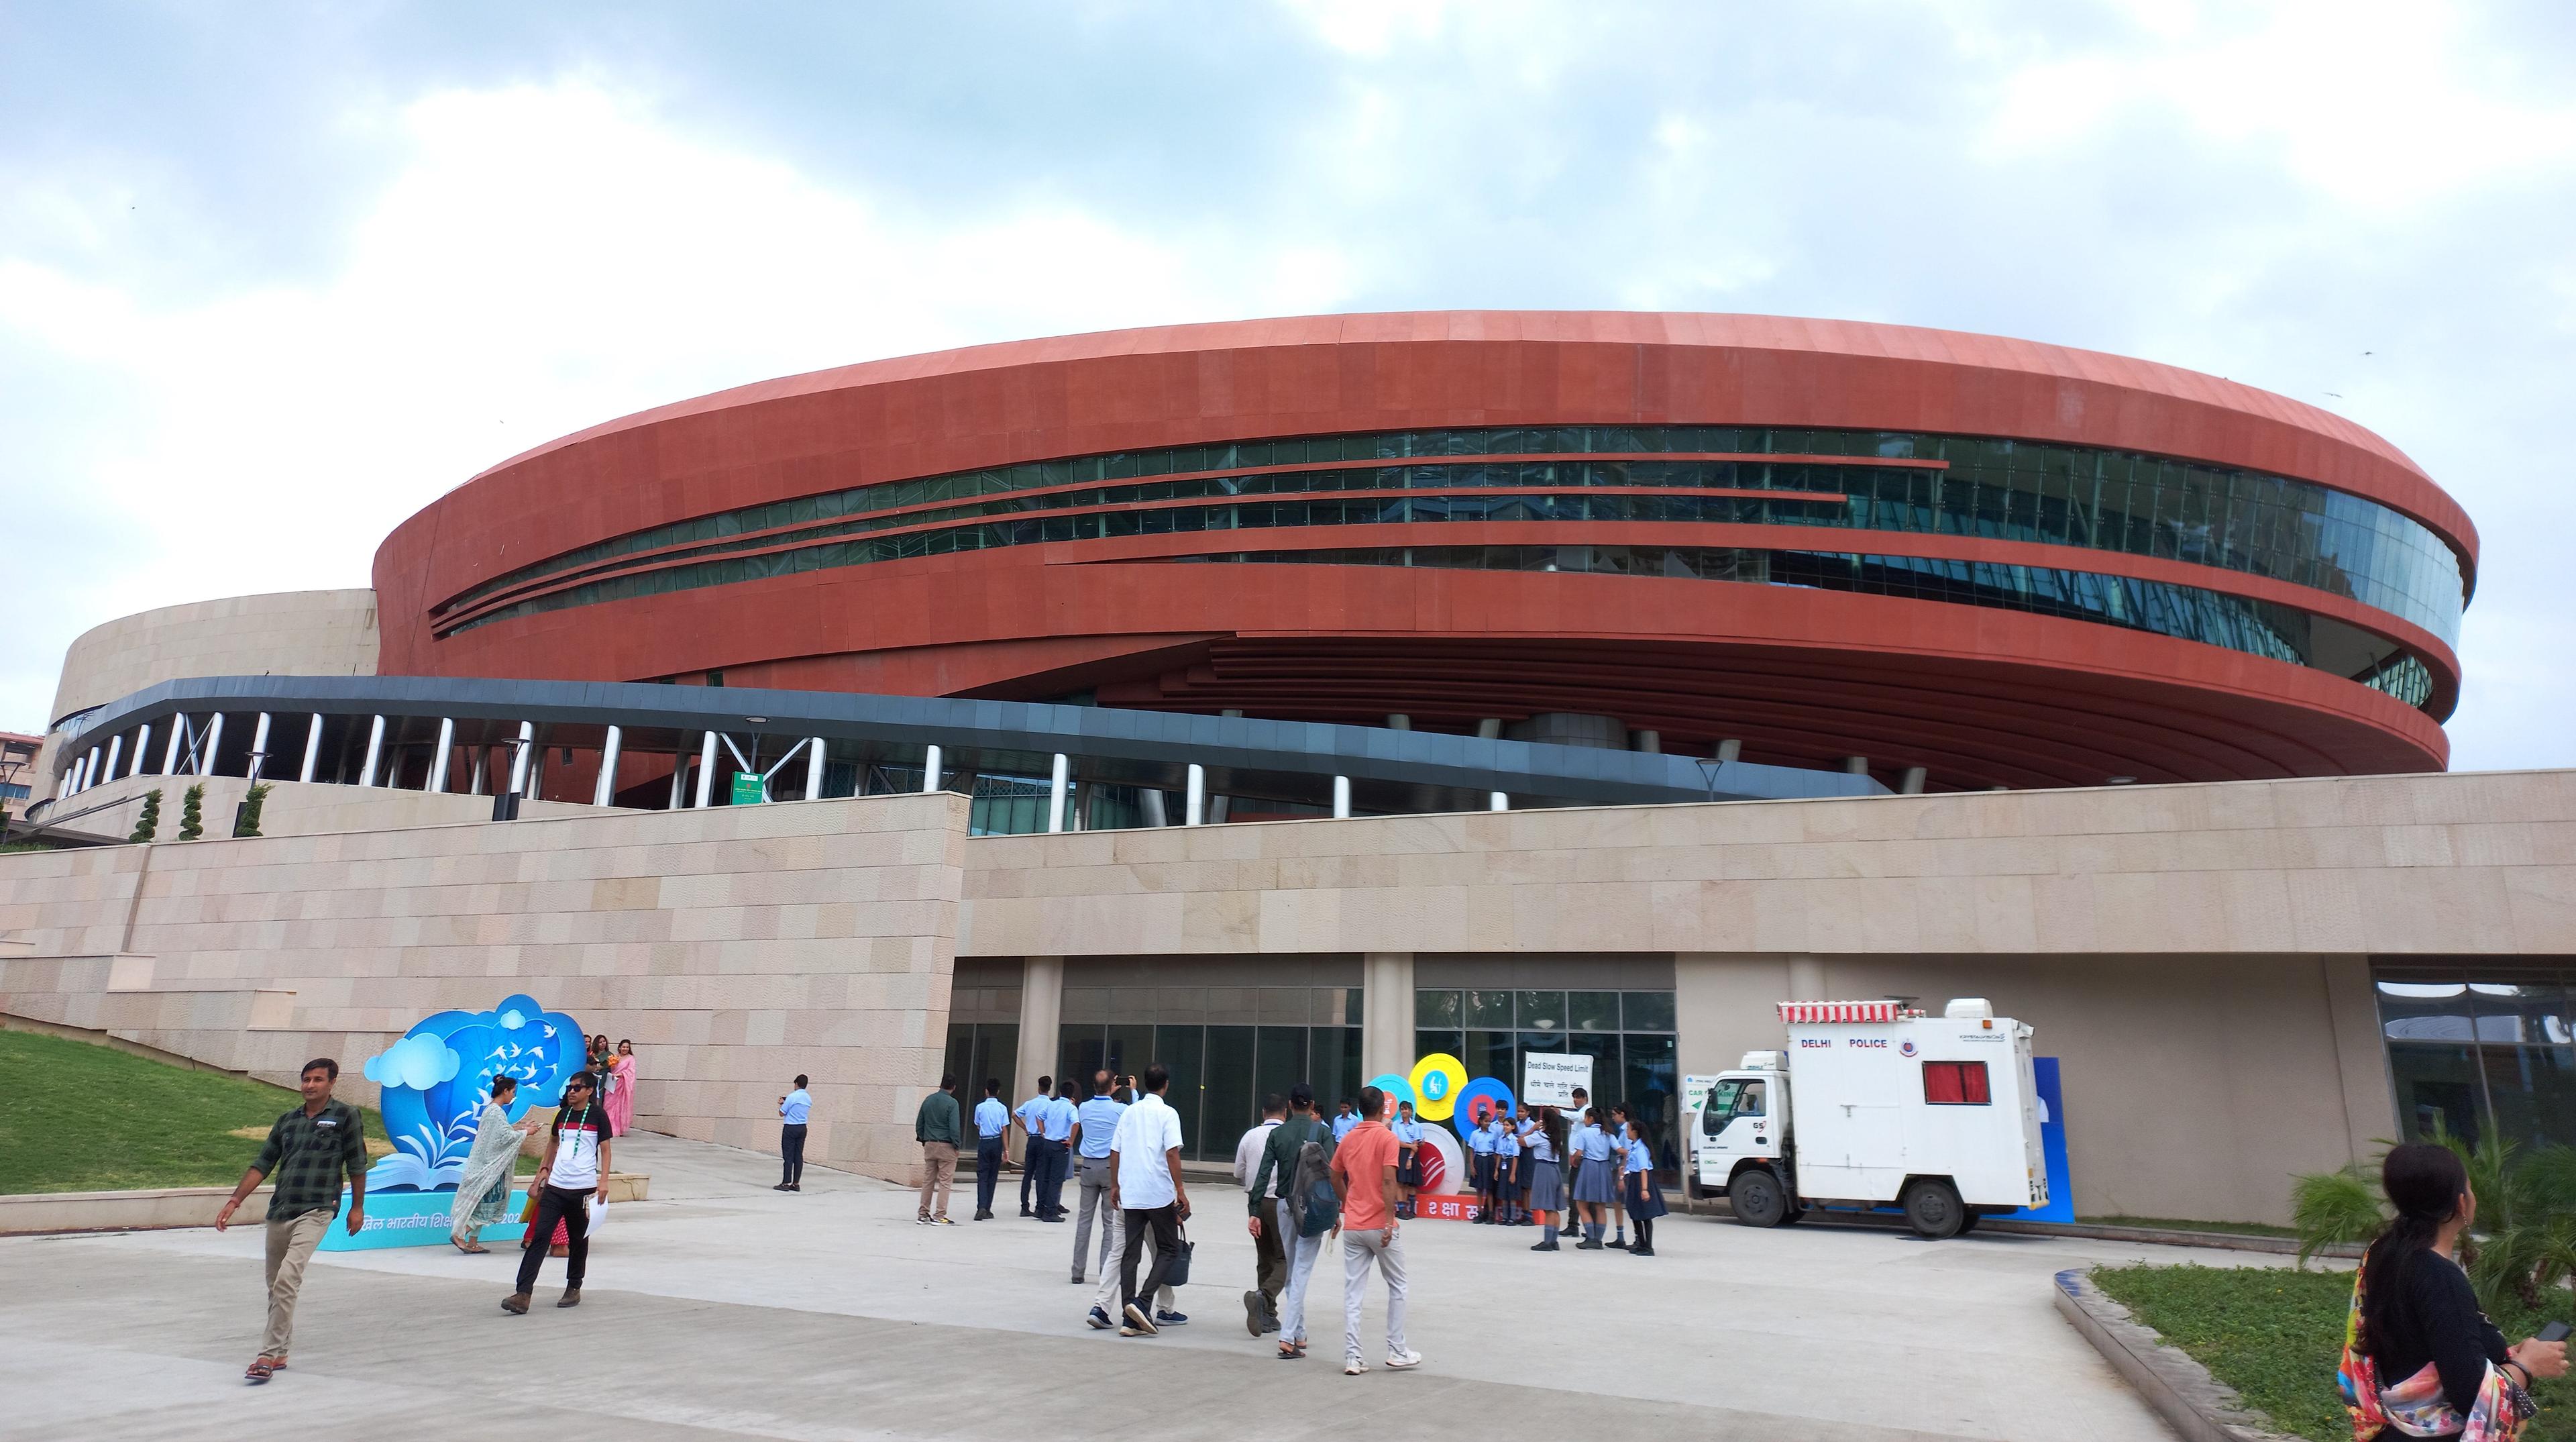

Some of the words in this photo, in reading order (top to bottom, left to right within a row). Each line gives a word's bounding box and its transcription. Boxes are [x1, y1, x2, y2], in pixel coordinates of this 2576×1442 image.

[1801, 1039, 1831, 1048] DELHI
[1849, 1039, 1888, 1048] POLICE
[1556, 1064, 1574, 1072] Speed
[1574, 1064, 1589, 1072] Limit
[360, 1215, 385, 1231] खिल
[386, 1213, 429, 1229] भारतीय
[429, 1212, 453, 1229] शिक्ष
[500, 1213, 521, 1224] 202
